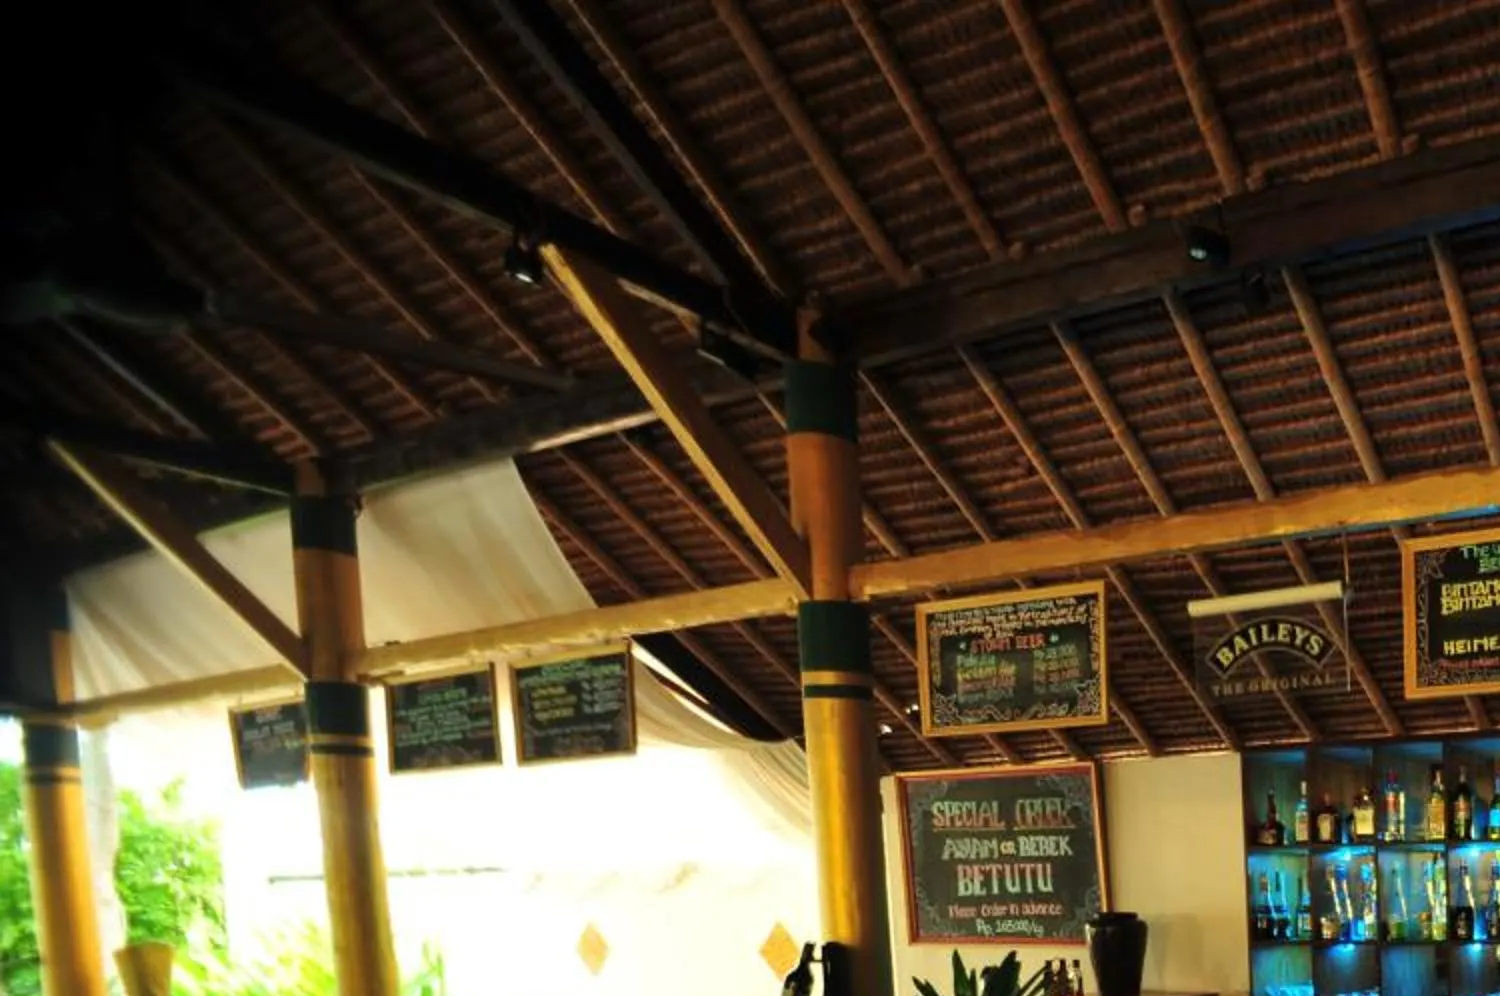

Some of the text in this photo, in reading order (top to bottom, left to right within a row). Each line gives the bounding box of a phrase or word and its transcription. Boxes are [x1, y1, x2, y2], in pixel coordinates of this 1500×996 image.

[1215, 622, 1326, 669] BAILEYS
[1210, 671, 1337, 698] THE ORIGINAL
[931, 799, 1006, 829] SPECIAL
[941, 837, 999, 861] AYAM
[956, 862, 1054, 897] BETUTU
